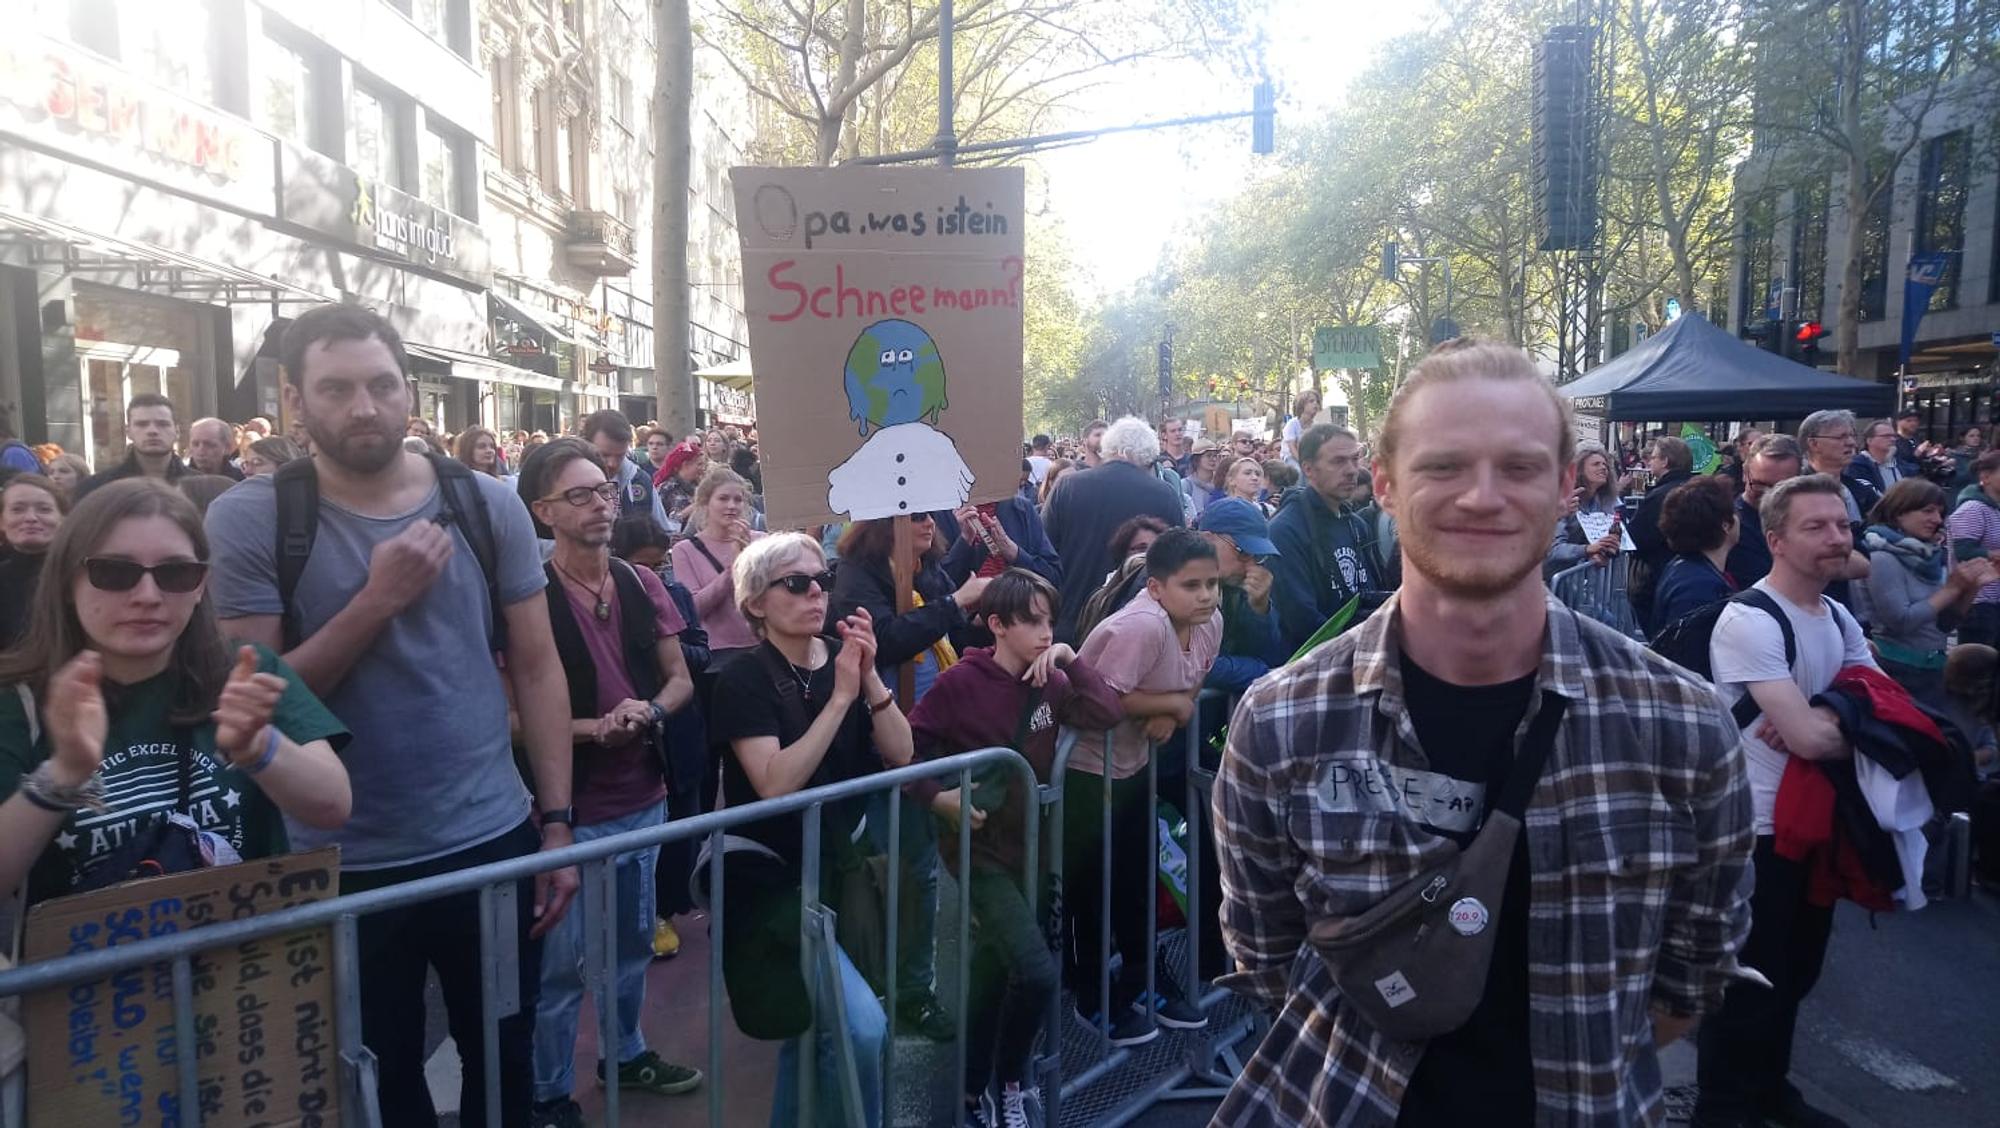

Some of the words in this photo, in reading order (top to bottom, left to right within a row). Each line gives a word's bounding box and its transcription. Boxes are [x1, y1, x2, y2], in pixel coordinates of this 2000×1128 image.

[867, 210, 926, 236] was
[284, 931, 324, 989] ist
[236, 992, 271, 1065] dass
[295, 1000, 328, 1085] nicht
[241, 1068, 274, 1117] die
